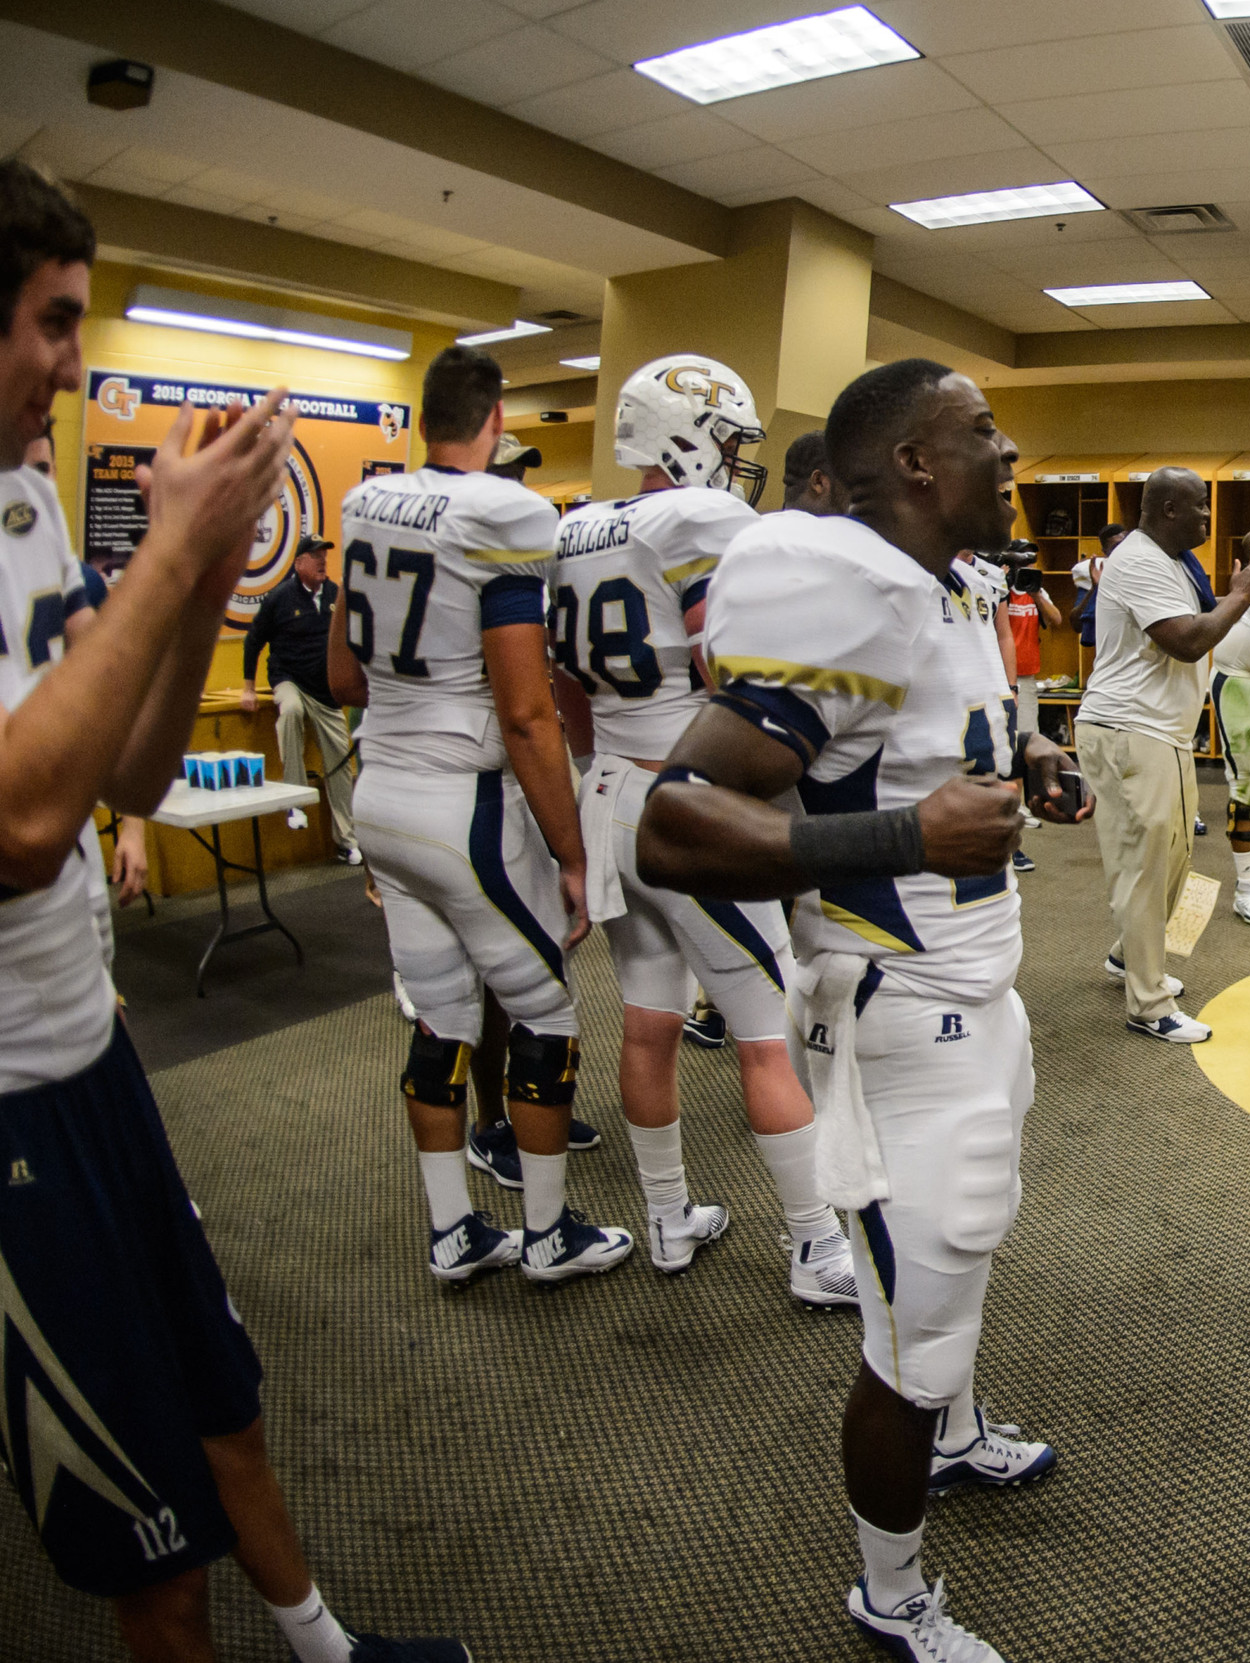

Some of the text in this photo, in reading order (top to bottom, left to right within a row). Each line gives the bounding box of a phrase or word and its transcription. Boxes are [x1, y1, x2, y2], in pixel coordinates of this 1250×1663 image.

[152, 384, 185, 401] 2015
[292, 397, 359, 419] FOOTBALL
[355, 485, 451, 533] STICKLER
[557, 507, 638, 561] SELLERS
[343, 538, 435, 677] 67
[555, 575, 664, 701] 98
[934, 1031, 972, 1043] RUSSELL
[432, 1223, 472, 1271] NIKE
[525, 1227, 568, 1271] NIKE
[132, 1505, 189, 1561] 112
